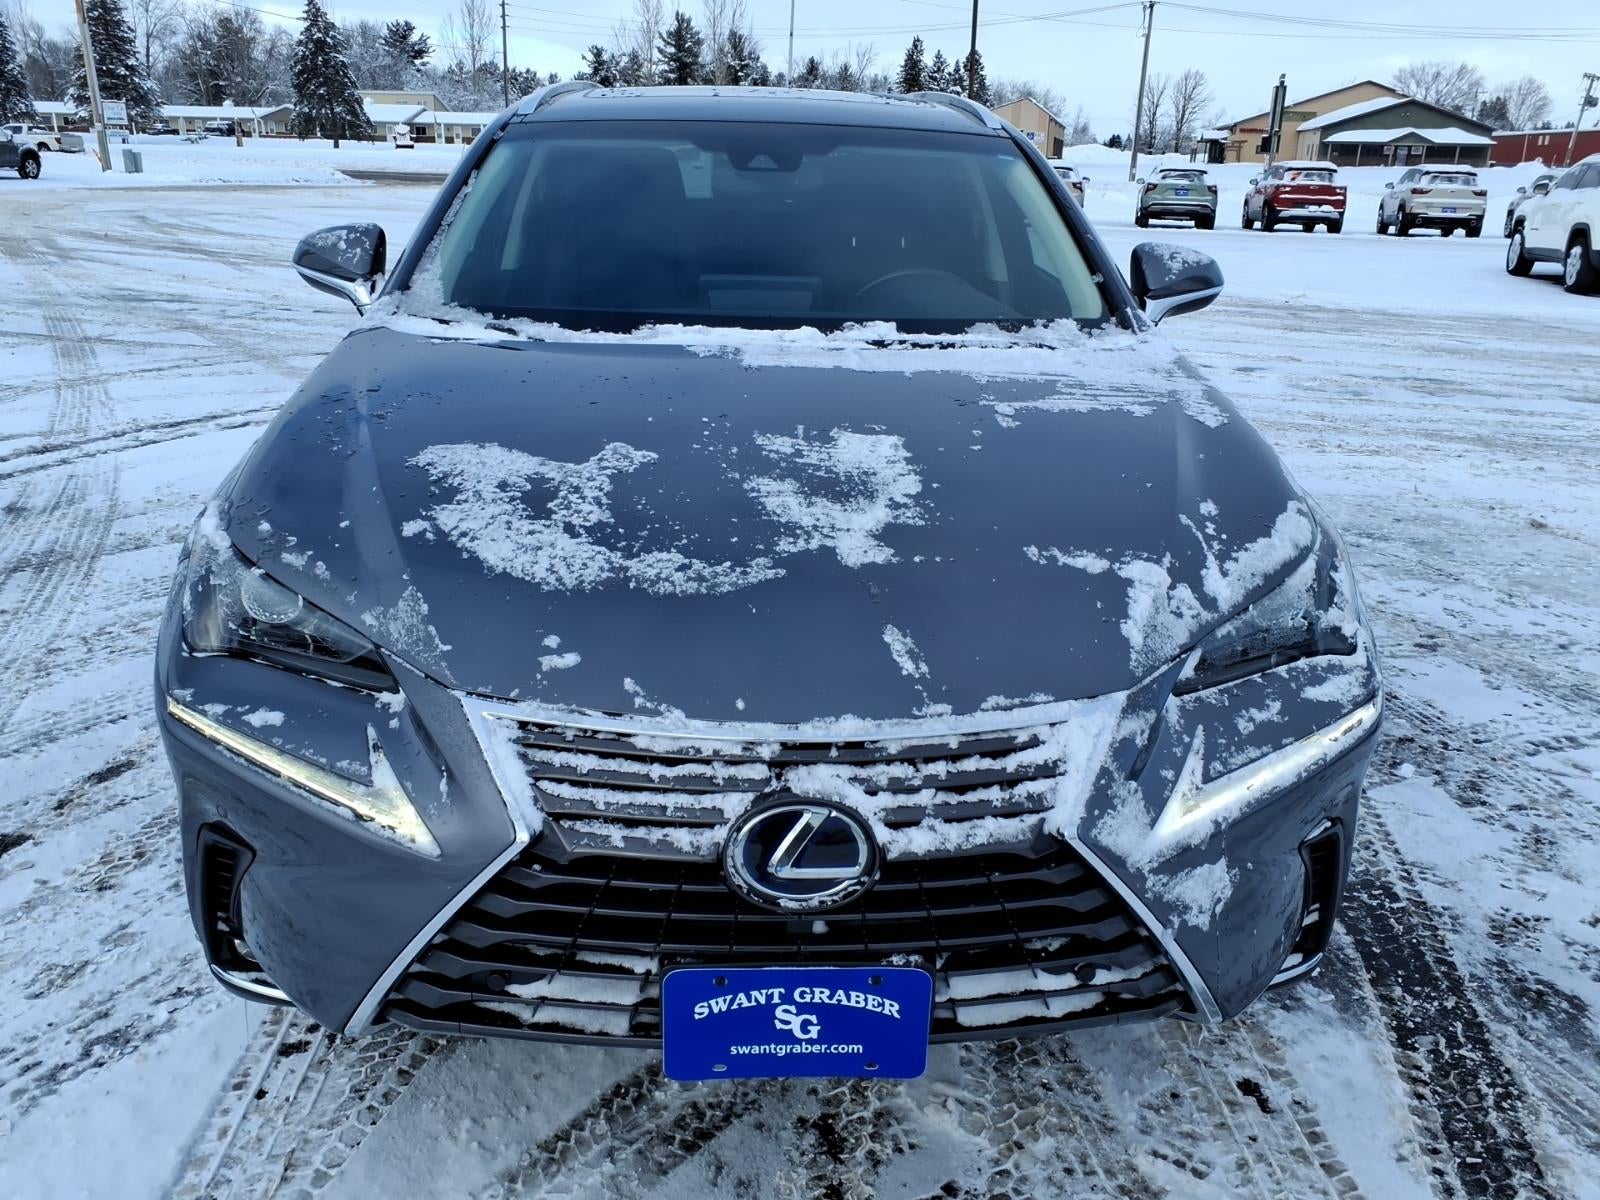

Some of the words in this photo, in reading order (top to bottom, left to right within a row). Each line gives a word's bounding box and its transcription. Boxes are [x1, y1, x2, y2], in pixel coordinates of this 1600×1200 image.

[694, 988, 785, 1019] SWANT
[793, 987, 901, 1018] GRABER
[774, 1005, 820, 1039] SG
[730, 1042, 863, 1056] swantgraber.com
